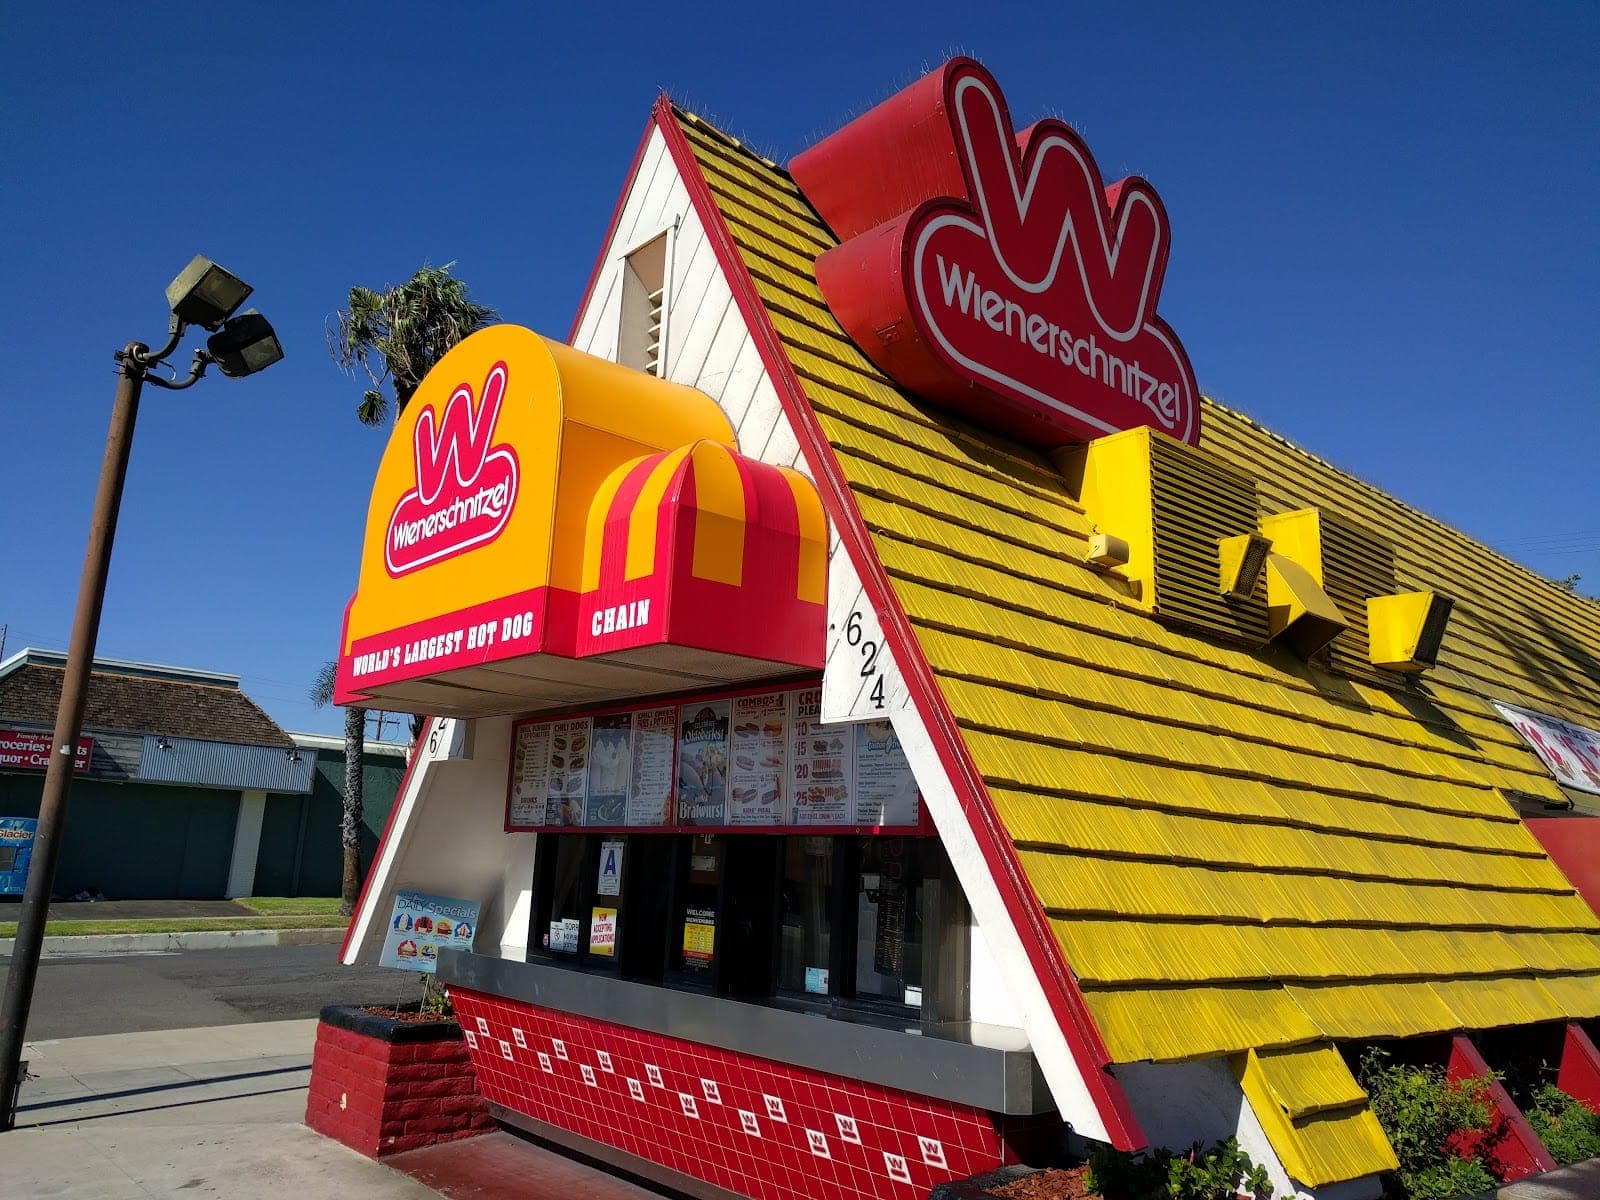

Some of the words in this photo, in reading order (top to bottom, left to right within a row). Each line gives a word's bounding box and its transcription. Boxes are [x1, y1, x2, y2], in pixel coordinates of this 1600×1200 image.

[936, 253, 1182, 429] Wienerschnitzel
[393, 475, 510, 552] Wienerschnitzel
[352, 647, 401, 677] WORLD'S
[404, 630, 463, 665] LARGEST
[467, 622, 498, 649] HOT
[501, 611, 534, 641] DOG
[591, 599, 651, 637] CHAIN
[737, 695, 775, 708] COMBOS
[798, 704, 821, 716] PLEA
[554, 722, 569, 732] CHILI
[570, 720, 589, 731] DOGS
[684, 727, 725, 743] Oktoberfest
[0, 740, 46, 752] roceries
[30, 753, 50, 766] Cra
[680, 800, 724, 819] Bratwurst
[603, 849, 616, 874] A
[398, 899, 427, 911] DAILY
[428, 902, 476, 918] Specials
[686, 907, 715, 918] WELCOME
[593, 923, 613, 933] ACCEPTING
